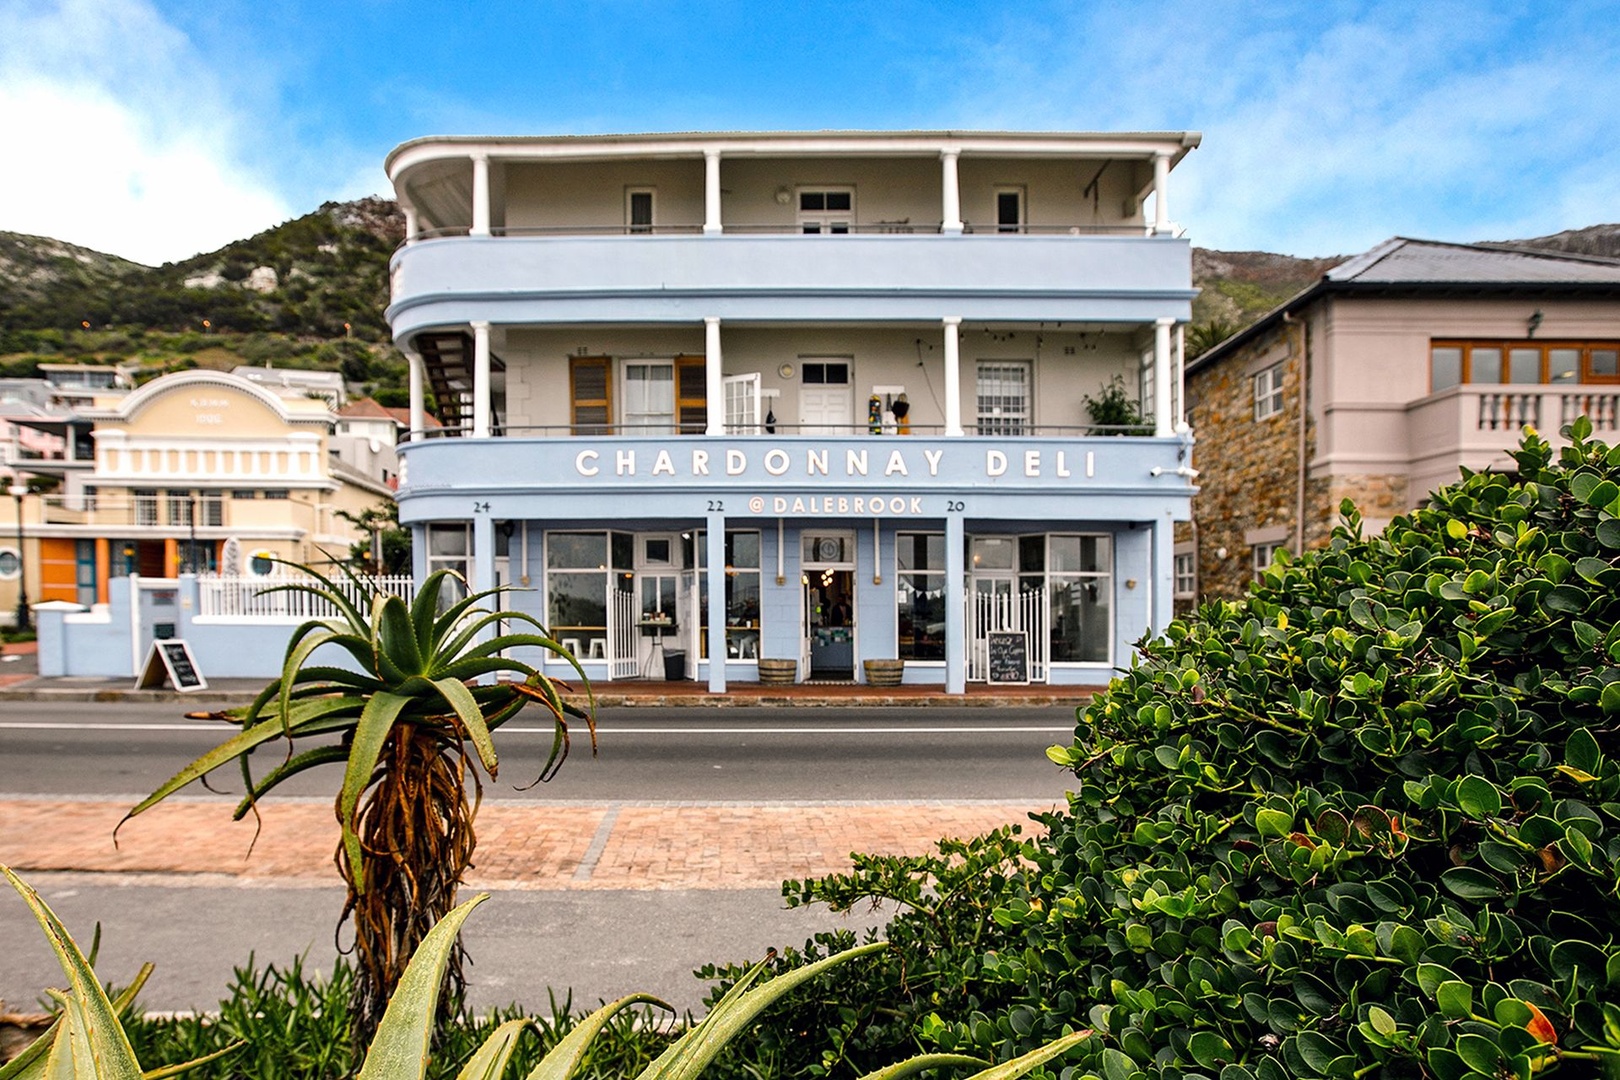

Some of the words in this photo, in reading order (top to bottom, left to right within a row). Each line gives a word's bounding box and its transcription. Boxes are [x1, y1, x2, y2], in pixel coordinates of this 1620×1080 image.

[575, 448, 944, 477] CHARDONNAY
[986, 450, 1095, 477] DELI
[473, 502, 490, 513] 24
[707, 500, 724, 512] 22
[748, 496, 765, 514] @
[773, 496, 923, 514] DALEBROOK
[947, 500, 965, 512] 20
